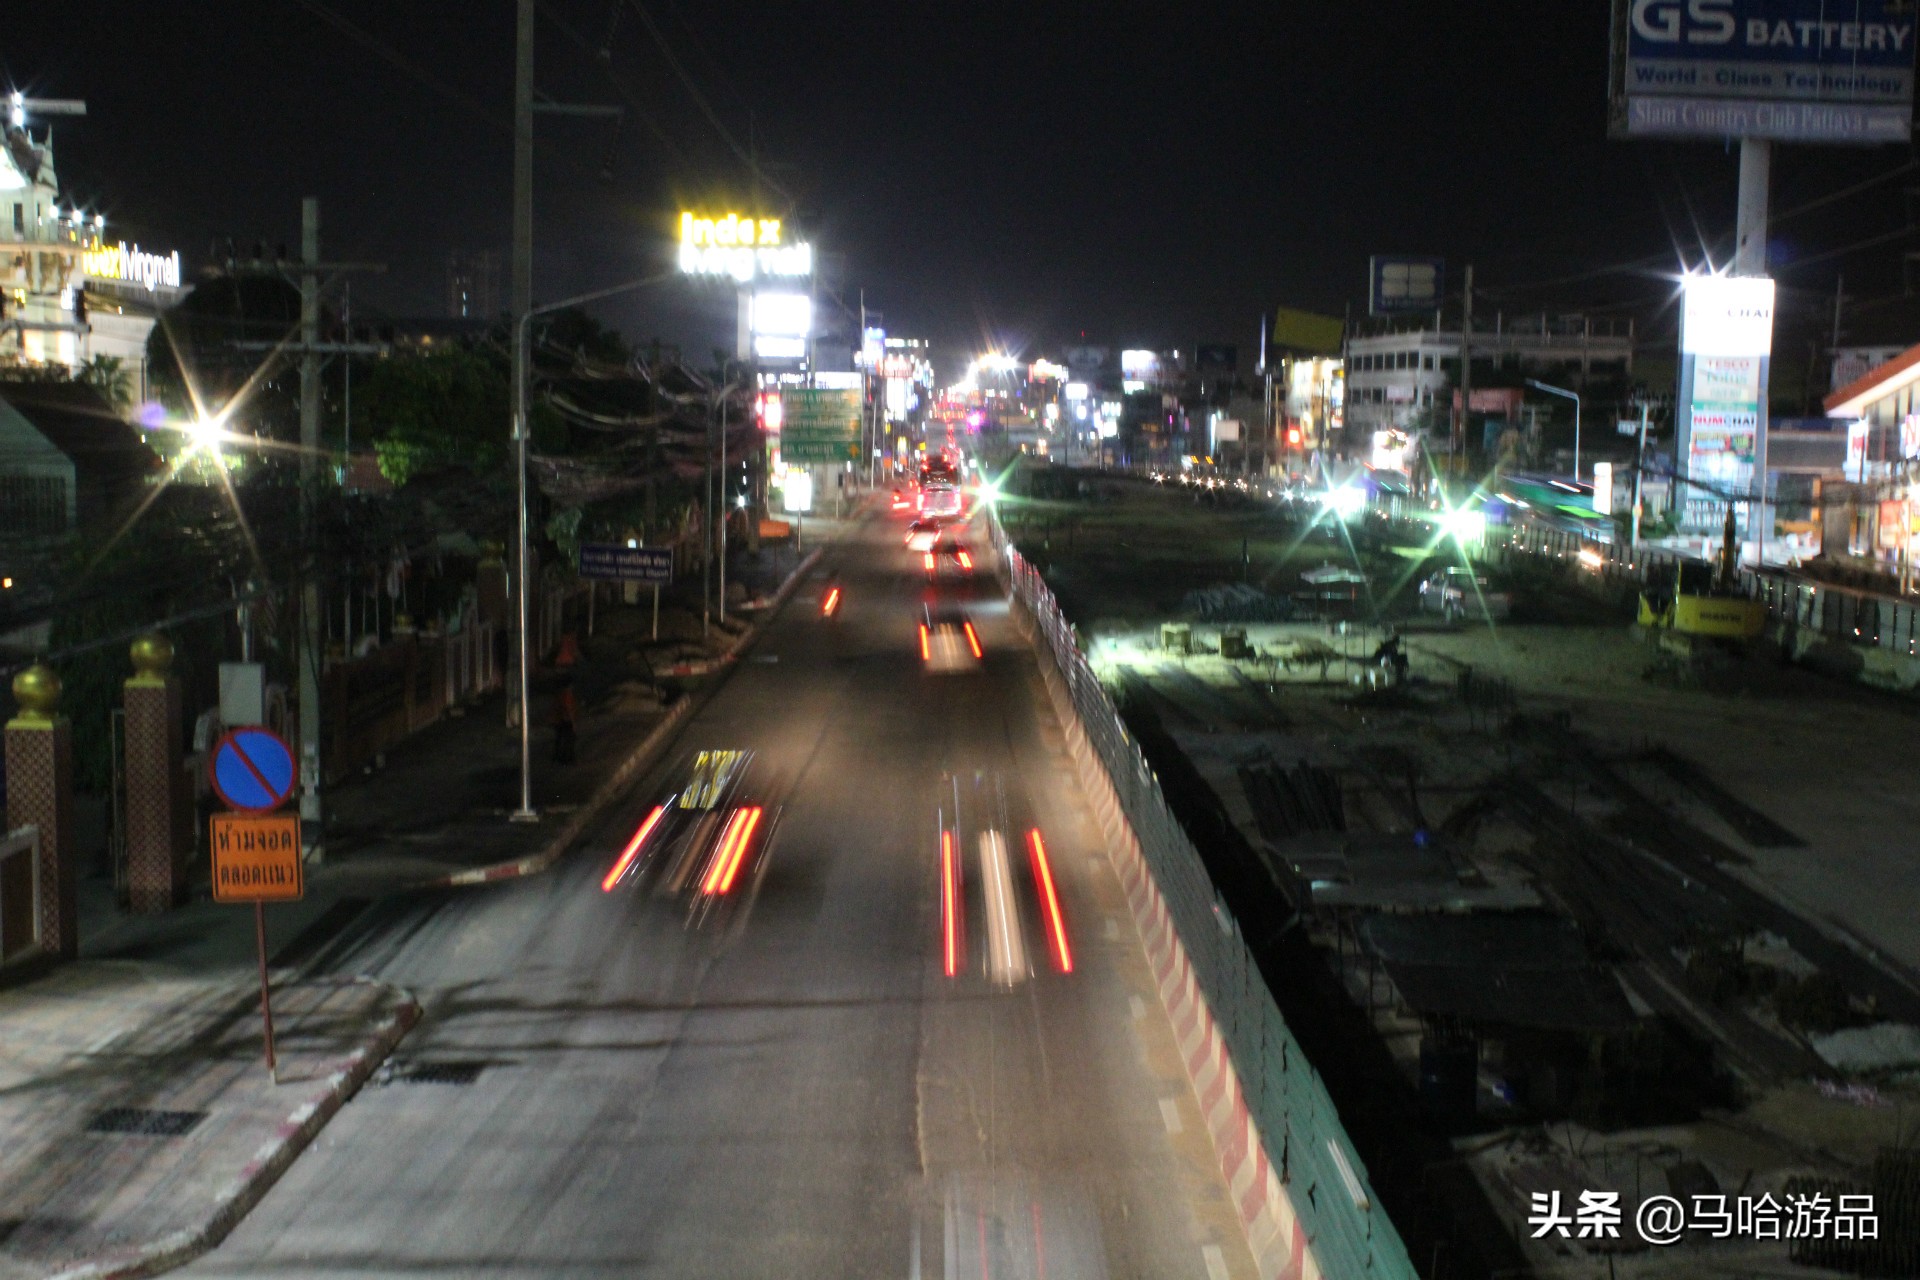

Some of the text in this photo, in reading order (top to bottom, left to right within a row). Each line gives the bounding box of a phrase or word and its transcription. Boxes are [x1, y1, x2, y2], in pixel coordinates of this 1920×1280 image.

[1631, 0, 1911, 51] GS BATTERY
[1635, 66, 1697, 85] World
[1715, 68, 1772, 86] Class
[1784, 72, 1902, 94] Technology
[1682, 103, 1747, 130] Country
[1755, 104, 1795, 127] Club
[1801, 106, 1863, 133] Pattaya
[220, 824, 291, 852] ห้ามจอด
[222, 865, 294, 886] ตลอดแนว
